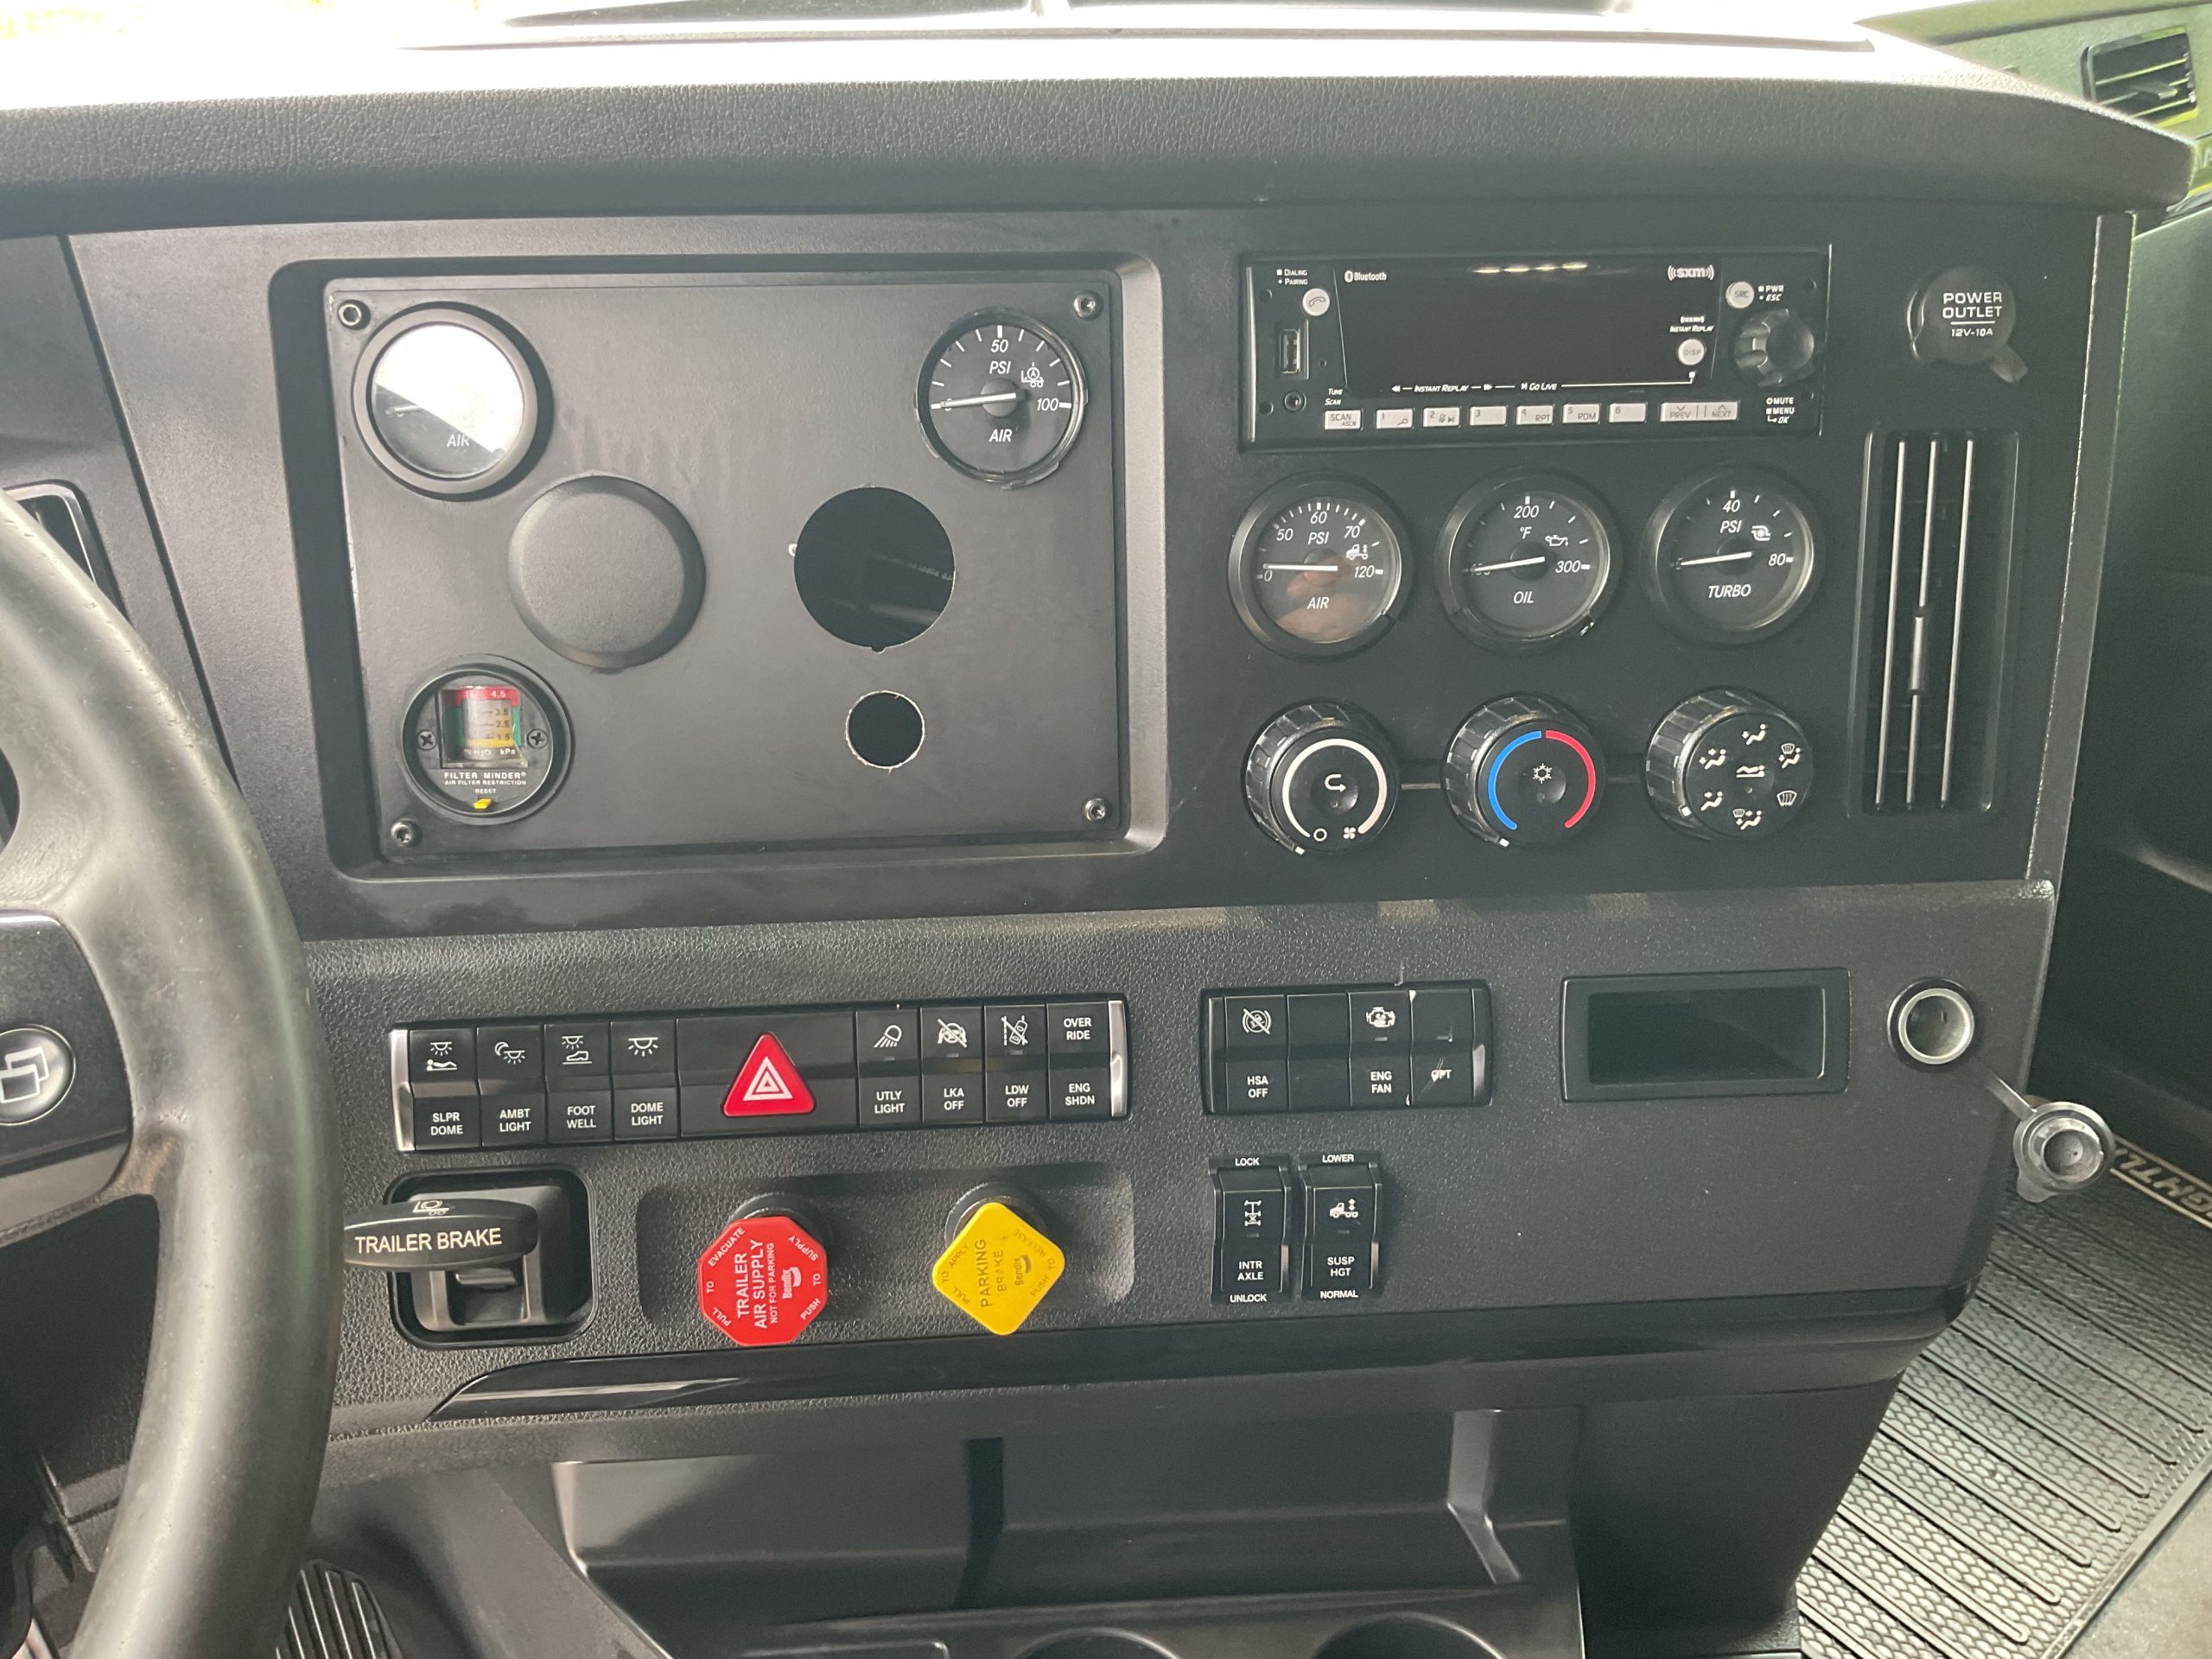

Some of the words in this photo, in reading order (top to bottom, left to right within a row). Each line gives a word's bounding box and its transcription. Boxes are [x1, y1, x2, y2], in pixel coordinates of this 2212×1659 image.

[1354, 271, 1387, 281] Bluetooth
[1674, 266, 1708, 279] sxm
[1943, 292, 2002, 304] POWER
[1942, 306, 2002, 318] OUTLET
[1951, 328, 1993, 337] 12V-10A
[991, 340, 1008, 353] 50
[989, 361, 1011, 375] PSI
[1037, 398, 1058, 411] 100
[447, 434, 470, 447] AIR
[989, 429, 1012, 442] AIR
[1514, 505, 1539, 518] 200
[1723, 499, 1741, 512] 40
[1310, 512, 1327, 524] 60
[1344, 525, 1360, 539] 70
[1720, 520, 1742, 533] PSI
[1276, 528, 1294, 541] 50
[1308, 531, 1329, 544] PSI
[1768, 553, 1786, 566] 80
[1354, 566, 1375, 578] 120
[1555, 560, 1581, 573] 300
[1264, 570, 1272, 582] 0
[1708, 584, 1751, 598] TURBO
[1306, 597, 1329, 609] AIR
[1513, 591, 1534, 604] OIL
[1064, 1017, 1092, 1028] OVER
[1066, 1030, 1091, 1040] RIDE
[1247, 1076, 1268, 1085] HSA
[1371, 1071, 1392, 1081] ENG
[944, 1088, 965, 1098] LKA
[1005, 1085, 1029, 1095] LDW
[1069, 1083, 1091, 1093] ENG
[1248, 1088, 1268, 1098] OFF
[1371, 1084, 1392, 1093] FAN
[876, 1091, 903, 1101] UTLY
[1007, 1097, 1028, 1107] OFF
[1065, 1095, 1095, 1106] SHDN
[567, 1106, 596, 1116] FOOT
[631, 1102, 664, 1113] DOME
[874, 1103, 905, 1114] LIGHT
[944, 1100, 965, 1110] OFF
[432, 1112, 460, 1122] SLPR
[499, 1109, 531, 1119] AMBT
[567, 1119, 597, 1129] WELL
[631, 1115, 664, 1126] LIGHT
[431, 1125, 463, 1135] DOME
[499, 1122, 531, 1132] LIGHT
[1235, 1157, 1259, 1166] LOCK
[1322, 1154, 1354, 1163] LOWER
[355, 1233, 432, 1253] TRAILER
[437, 1227, 502, 1249] BRAKE
[1014, 1229, 1046, 1257] RELEASE
[708, 1227, 746, 1267] EVACUATE
[788, 1235, 819, 1262] SUPPLY
[949, 1244, 969, 1268] APPLY
[1327, 1257, 1354, 1265] SUSP
[766, 1243, 776, 1282] PARKING
[1048, 1258, 1055, 1270] TO
[1239, 1261, 1262, 1270] INTR
[750, 1239, 766, 1300] SUPPLY
[975, 1239, 992, 1308] PARKING
[995, 1251, 1007, 1291] BRAKE
[1013, 1257, 1023, 1285] Bendix
[1330, 1268, 1351, 1277] HGT
[813, 1273, 821, 1286] TO
[942, 1271, 949, 1284] TO
[1237, 1272, 1264, 1281] AXLE
[707, 1281, 714, 1294] TO
[735, 1252, 750, 1318] TRAILER
[782, 1269, 793, 1299] Bendix
[1031, 1275, 1050, 1297] PUSH
[953, 1287, 971, 1305] PULL
[1230, 1294, 1267, 1303] UNLOCK
[1320, 1290, 1358, 1299] NORMAL
[800, 1298, 821, 1320] PUSH
[712, 1307, 732, 1327] PULL
[754, 1303, 767, 1328] AIR
